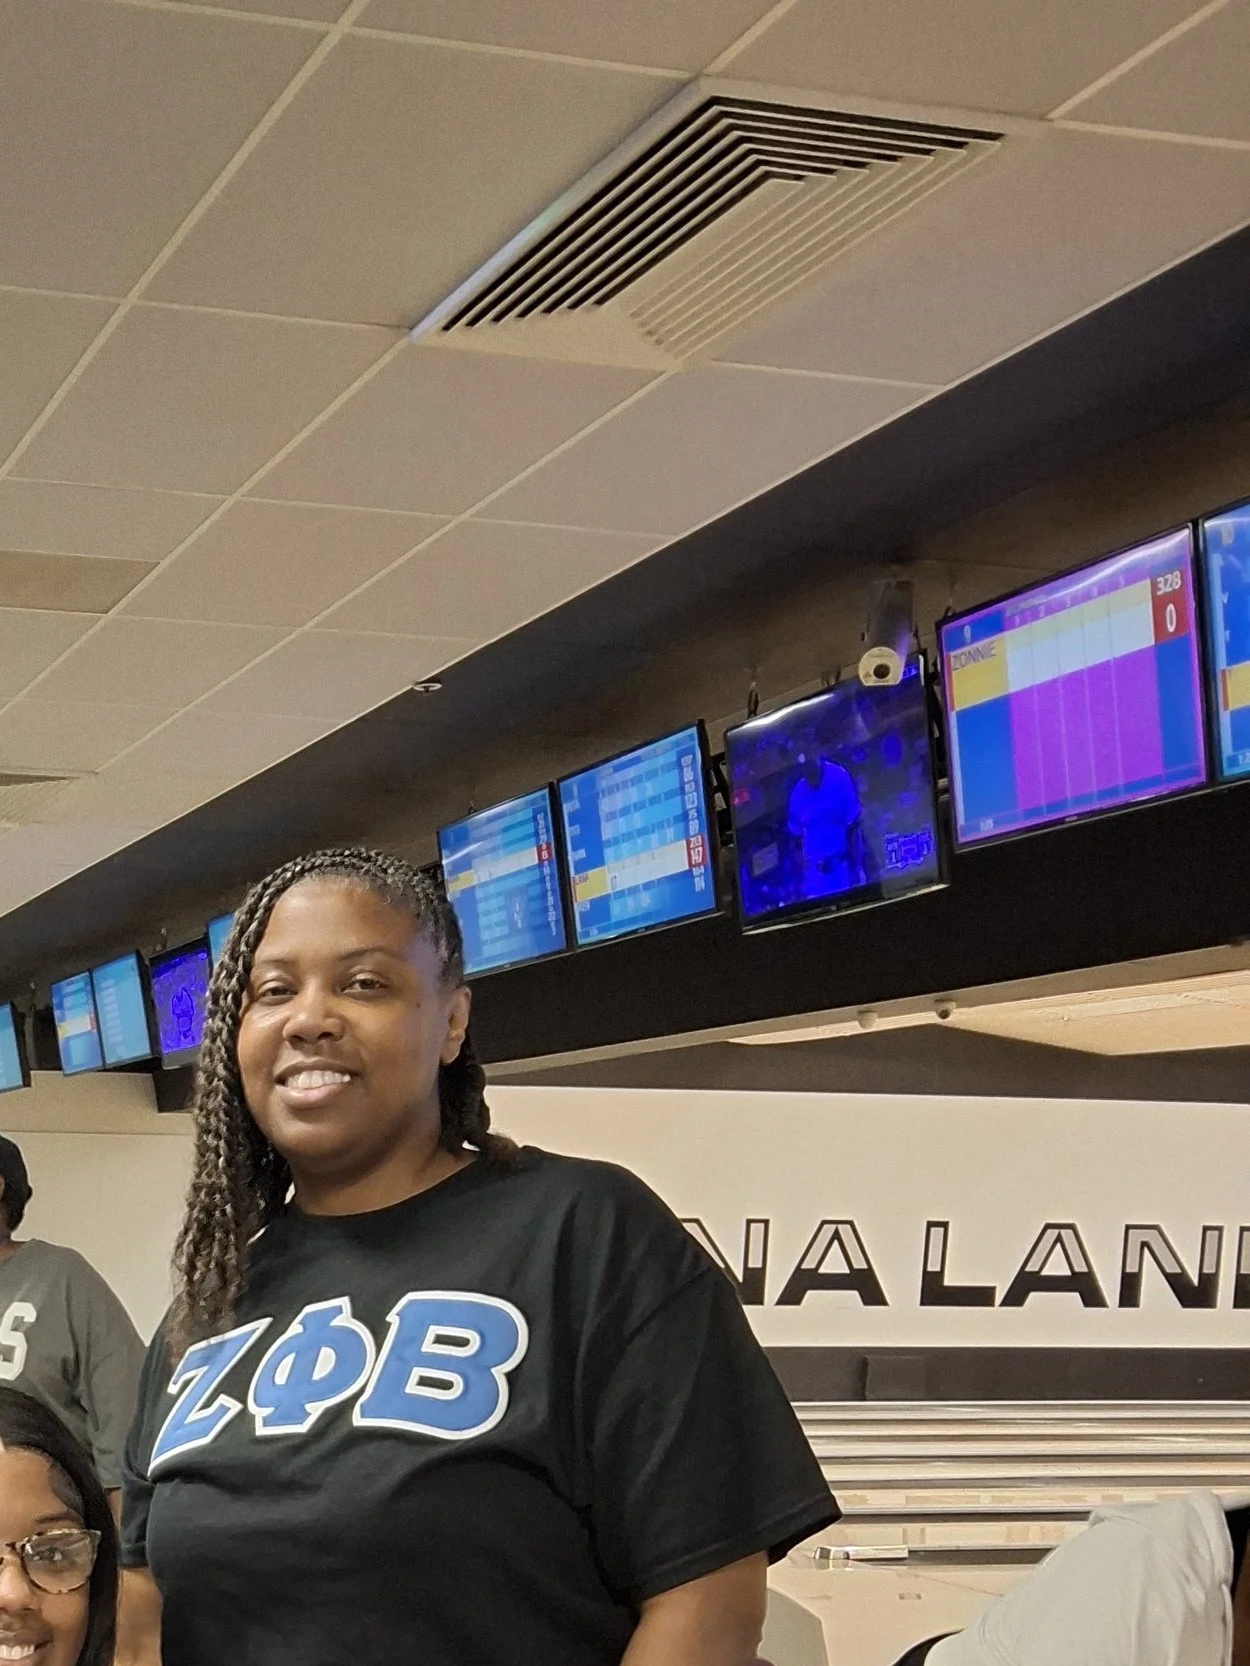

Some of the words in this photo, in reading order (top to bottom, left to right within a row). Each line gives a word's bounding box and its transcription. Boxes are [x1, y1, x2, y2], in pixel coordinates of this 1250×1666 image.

[1155, 571, 1182, 596] 328
[1165, 603, 1177, 633] 0
[919, 1219, 1250, 1310] LAN
